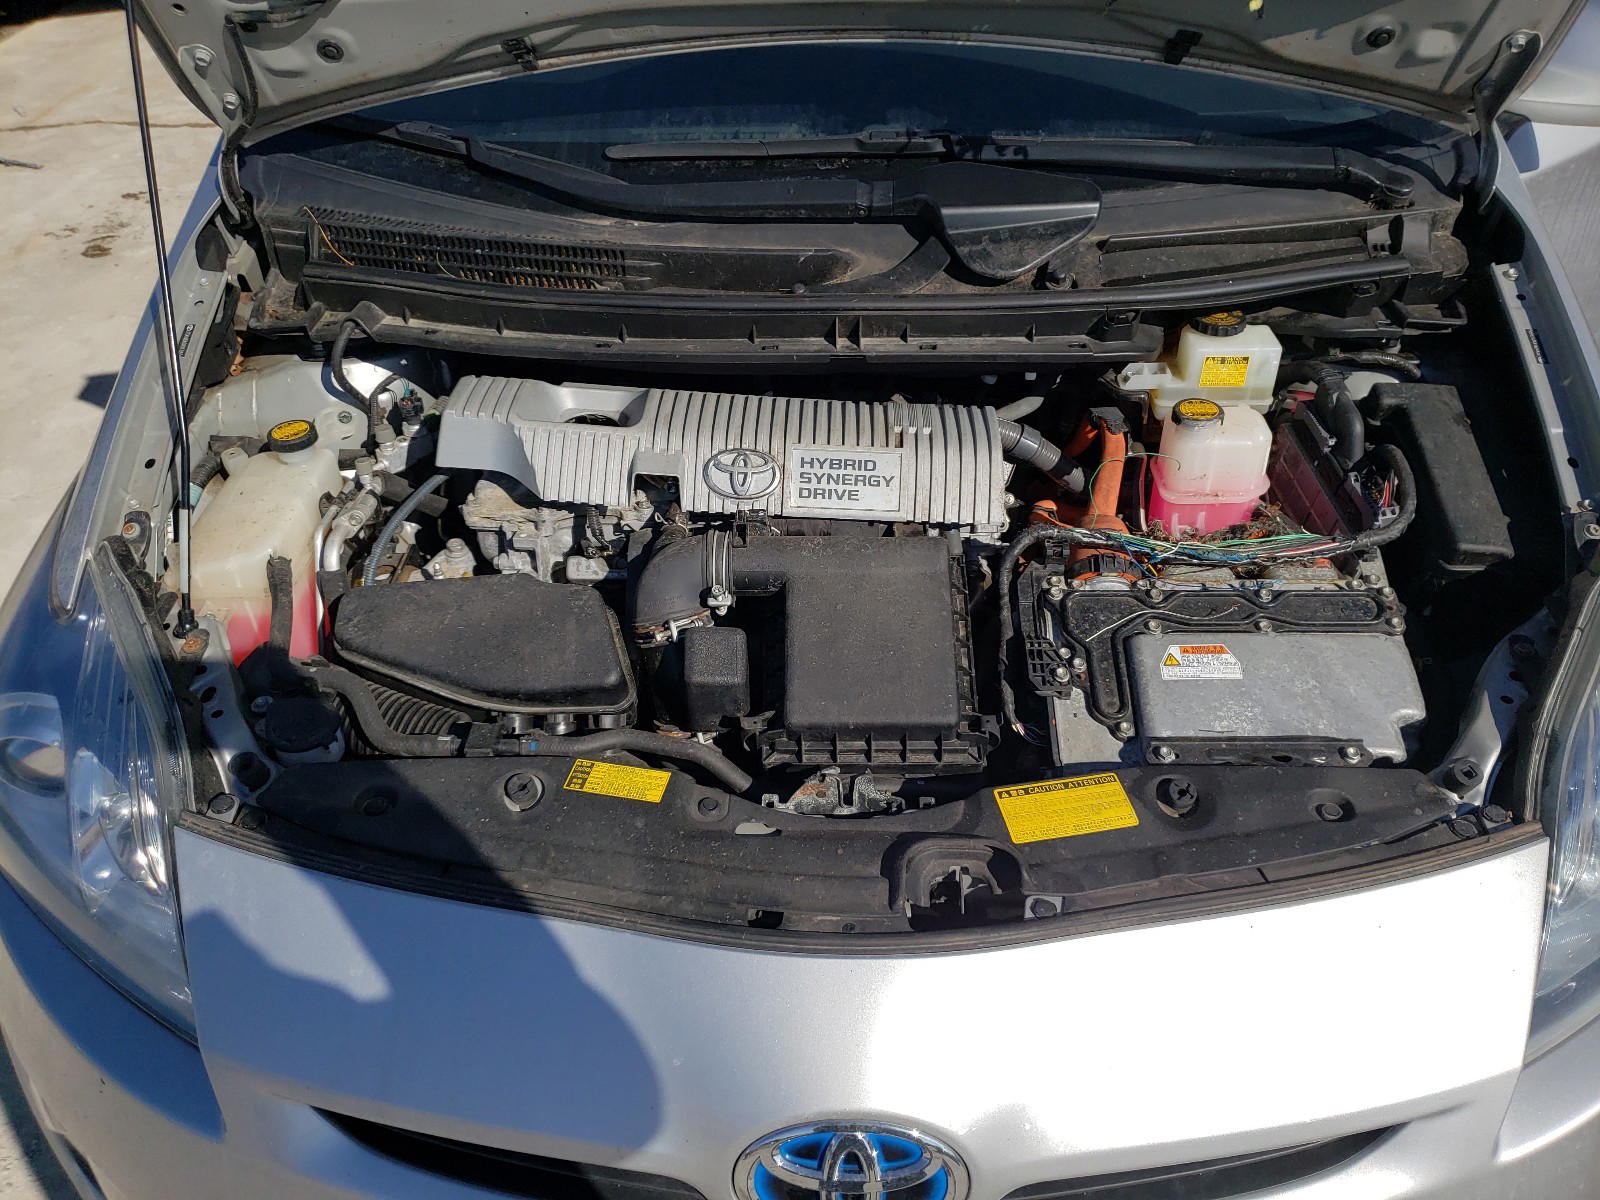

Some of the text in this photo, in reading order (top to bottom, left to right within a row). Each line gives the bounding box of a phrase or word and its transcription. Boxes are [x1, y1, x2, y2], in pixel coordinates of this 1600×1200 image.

[800, 457, 877, 471] HYBRID
[799, 472, 895, 487] SYNERGY
[798, 487, 860, 501] DRIVE
[1028, 783, 1065, 794] CAUTION
[1068, 775, 1115, 788] ATTENTION
